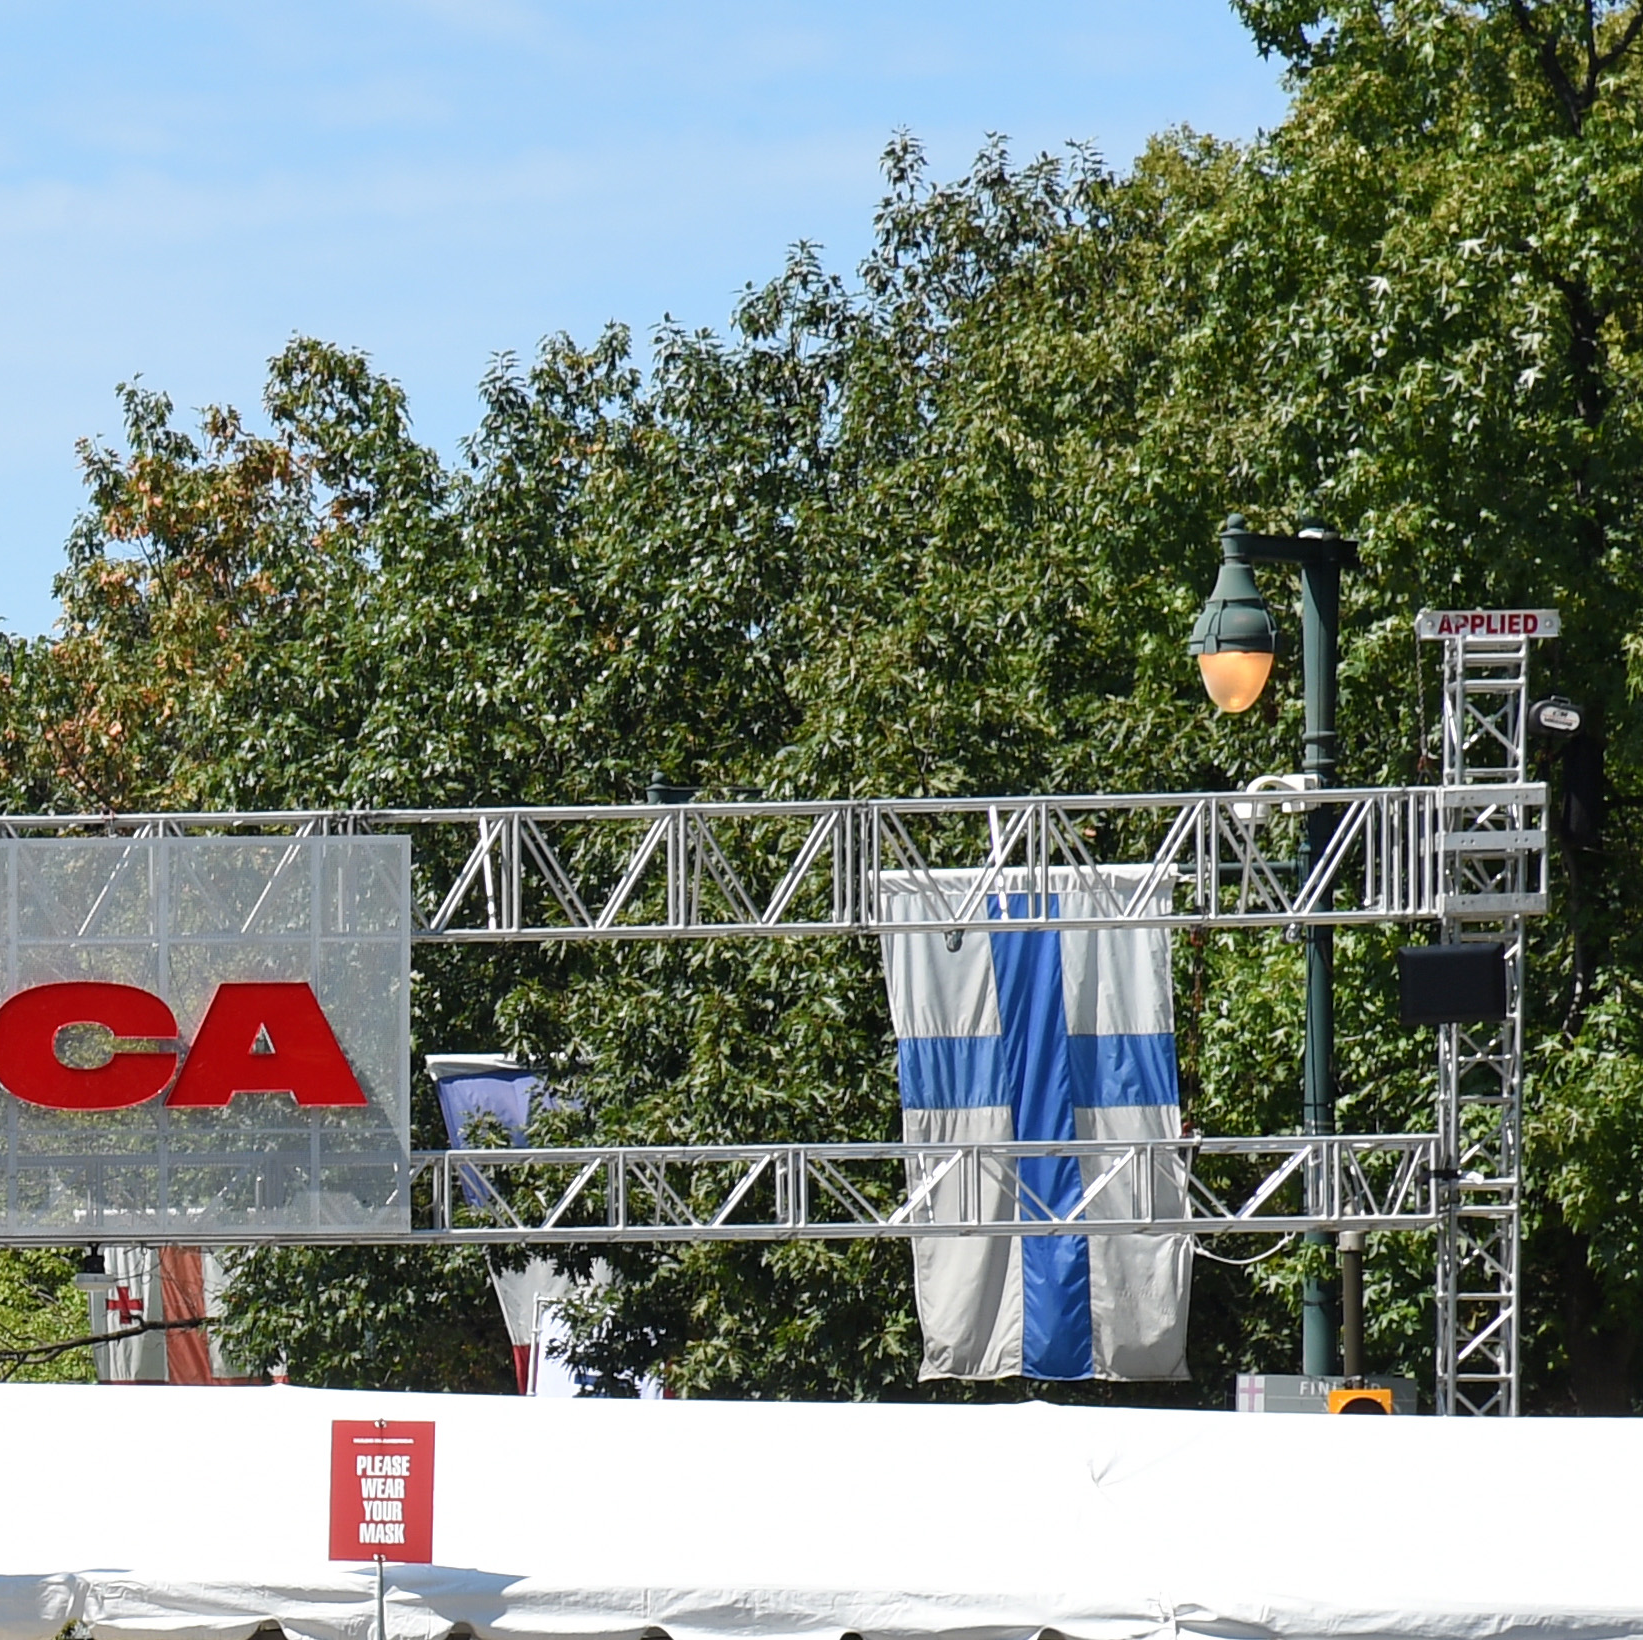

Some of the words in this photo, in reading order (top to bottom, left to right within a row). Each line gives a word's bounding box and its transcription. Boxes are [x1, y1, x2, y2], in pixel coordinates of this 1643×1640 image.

[1438, 613, 1538, 635] APPLIED
[1299, 1379, 1381, 1396] FIND
[356, 1455, 411, 1476] PLEASE
[361, 1478, 405, 1499] WEAR
[363, 1500, 403, 1522] YOUR
[359, 1522, 405, 1544] MASK
